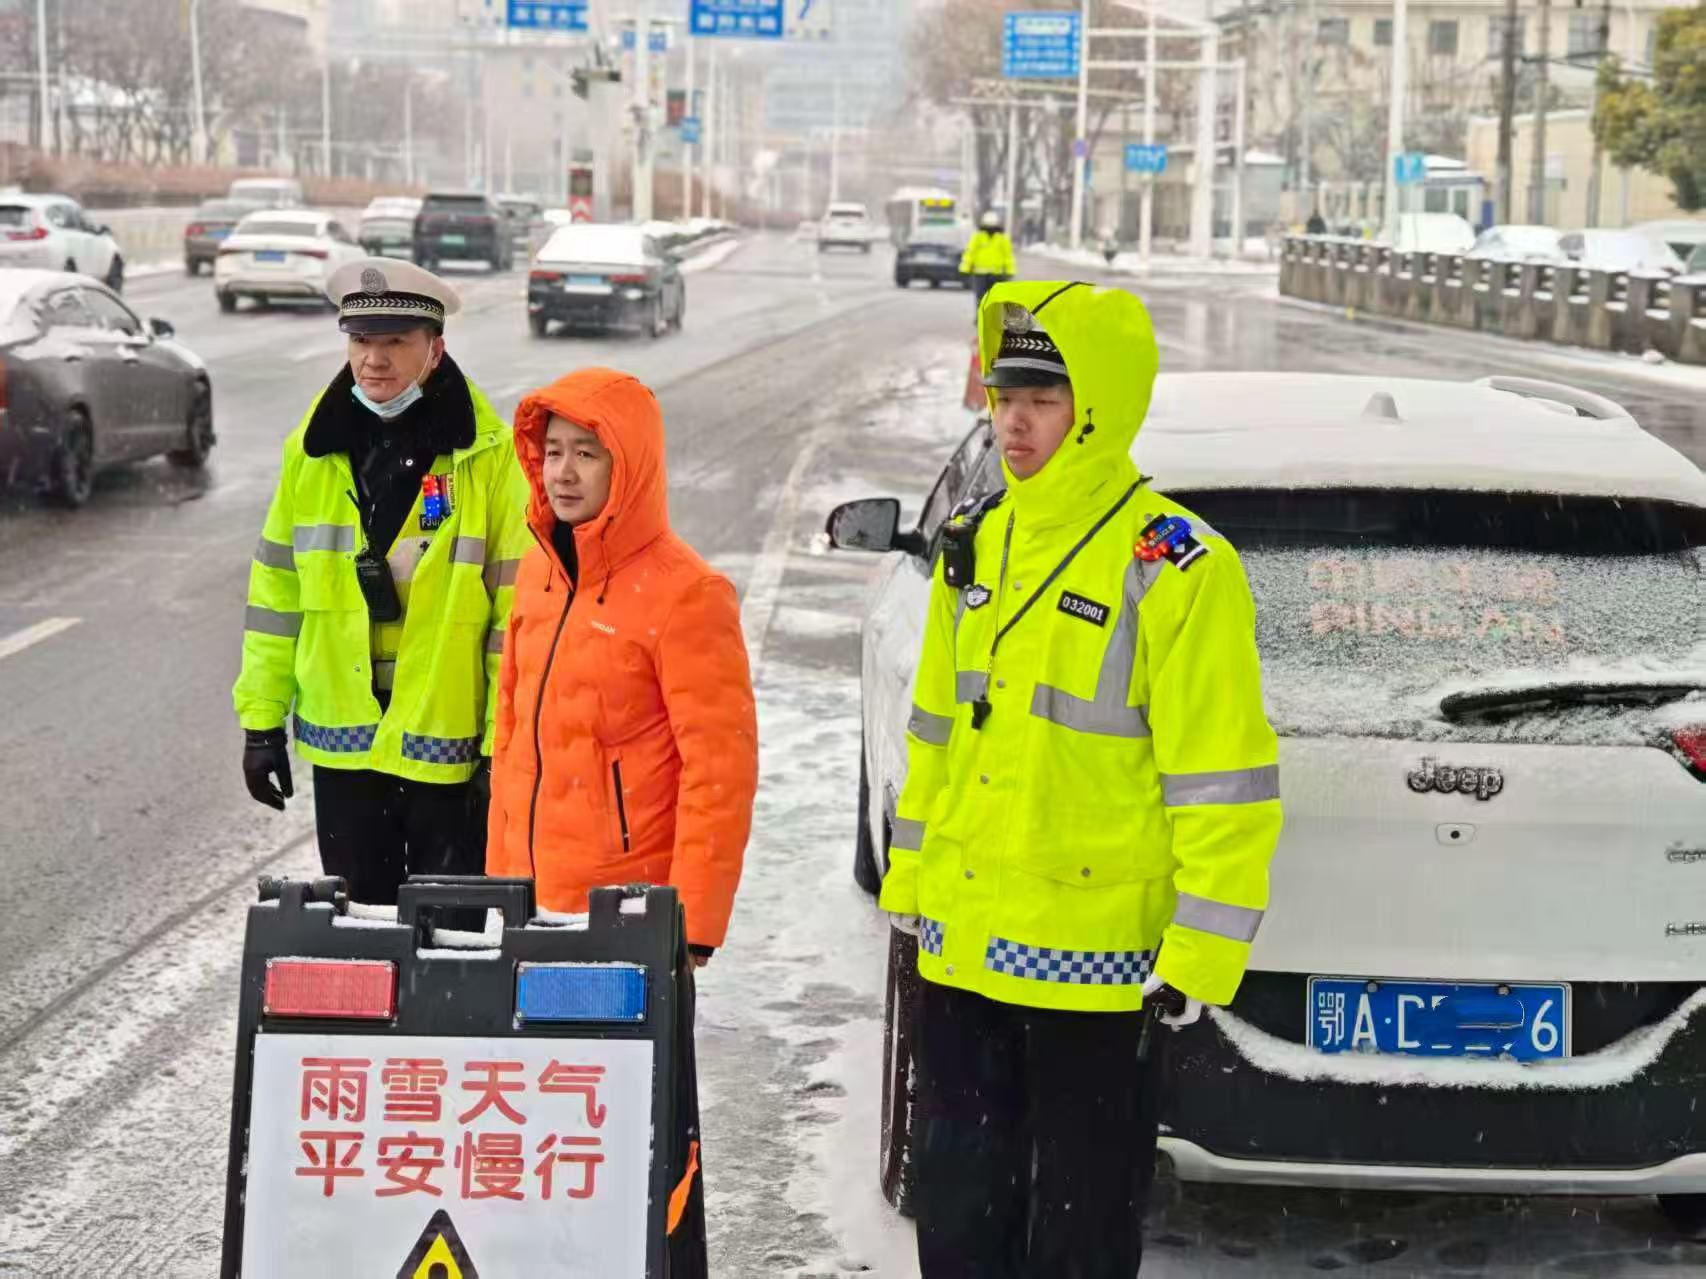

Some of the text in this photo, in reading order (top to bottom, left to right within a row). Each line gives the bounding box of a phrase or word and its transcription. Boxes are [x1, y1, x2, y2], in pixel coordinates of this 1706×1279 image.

[1062, 595, 1105, 622] 032001
[1407, 756, 1504, 801] Jeep
[300, 1056, 608, 1130] 雨雪天气
[294, 1130, 606, 1202] 平安慢行
